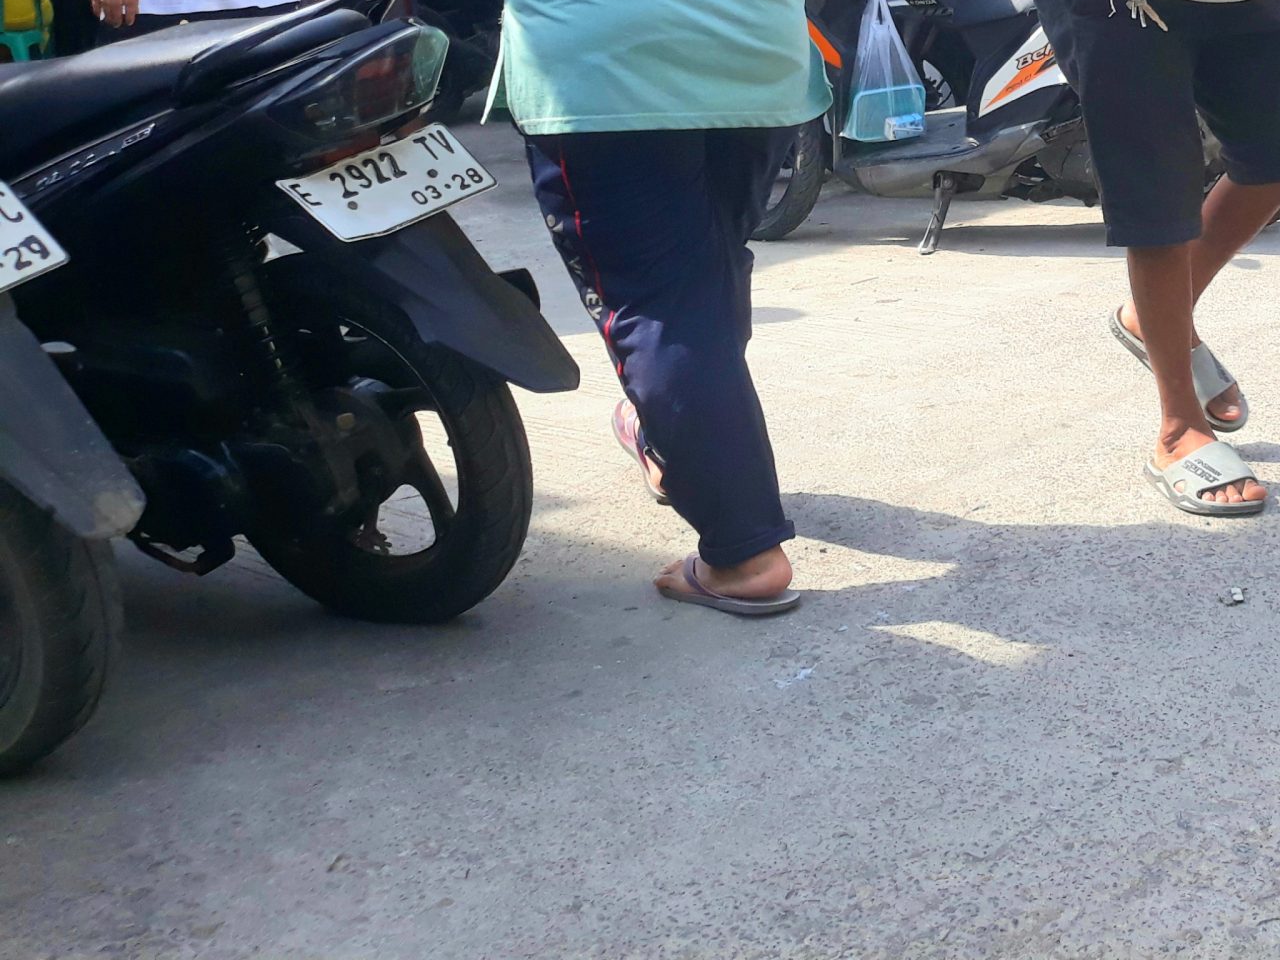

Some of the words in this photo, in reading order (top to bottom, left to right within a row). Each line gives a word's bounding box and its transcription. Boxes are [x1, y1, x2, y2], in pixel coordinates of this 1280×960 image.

[289, 183, 322, 206] E
[329, 152, 408, 199] 2922
[413, 129, 455, 161] TV
